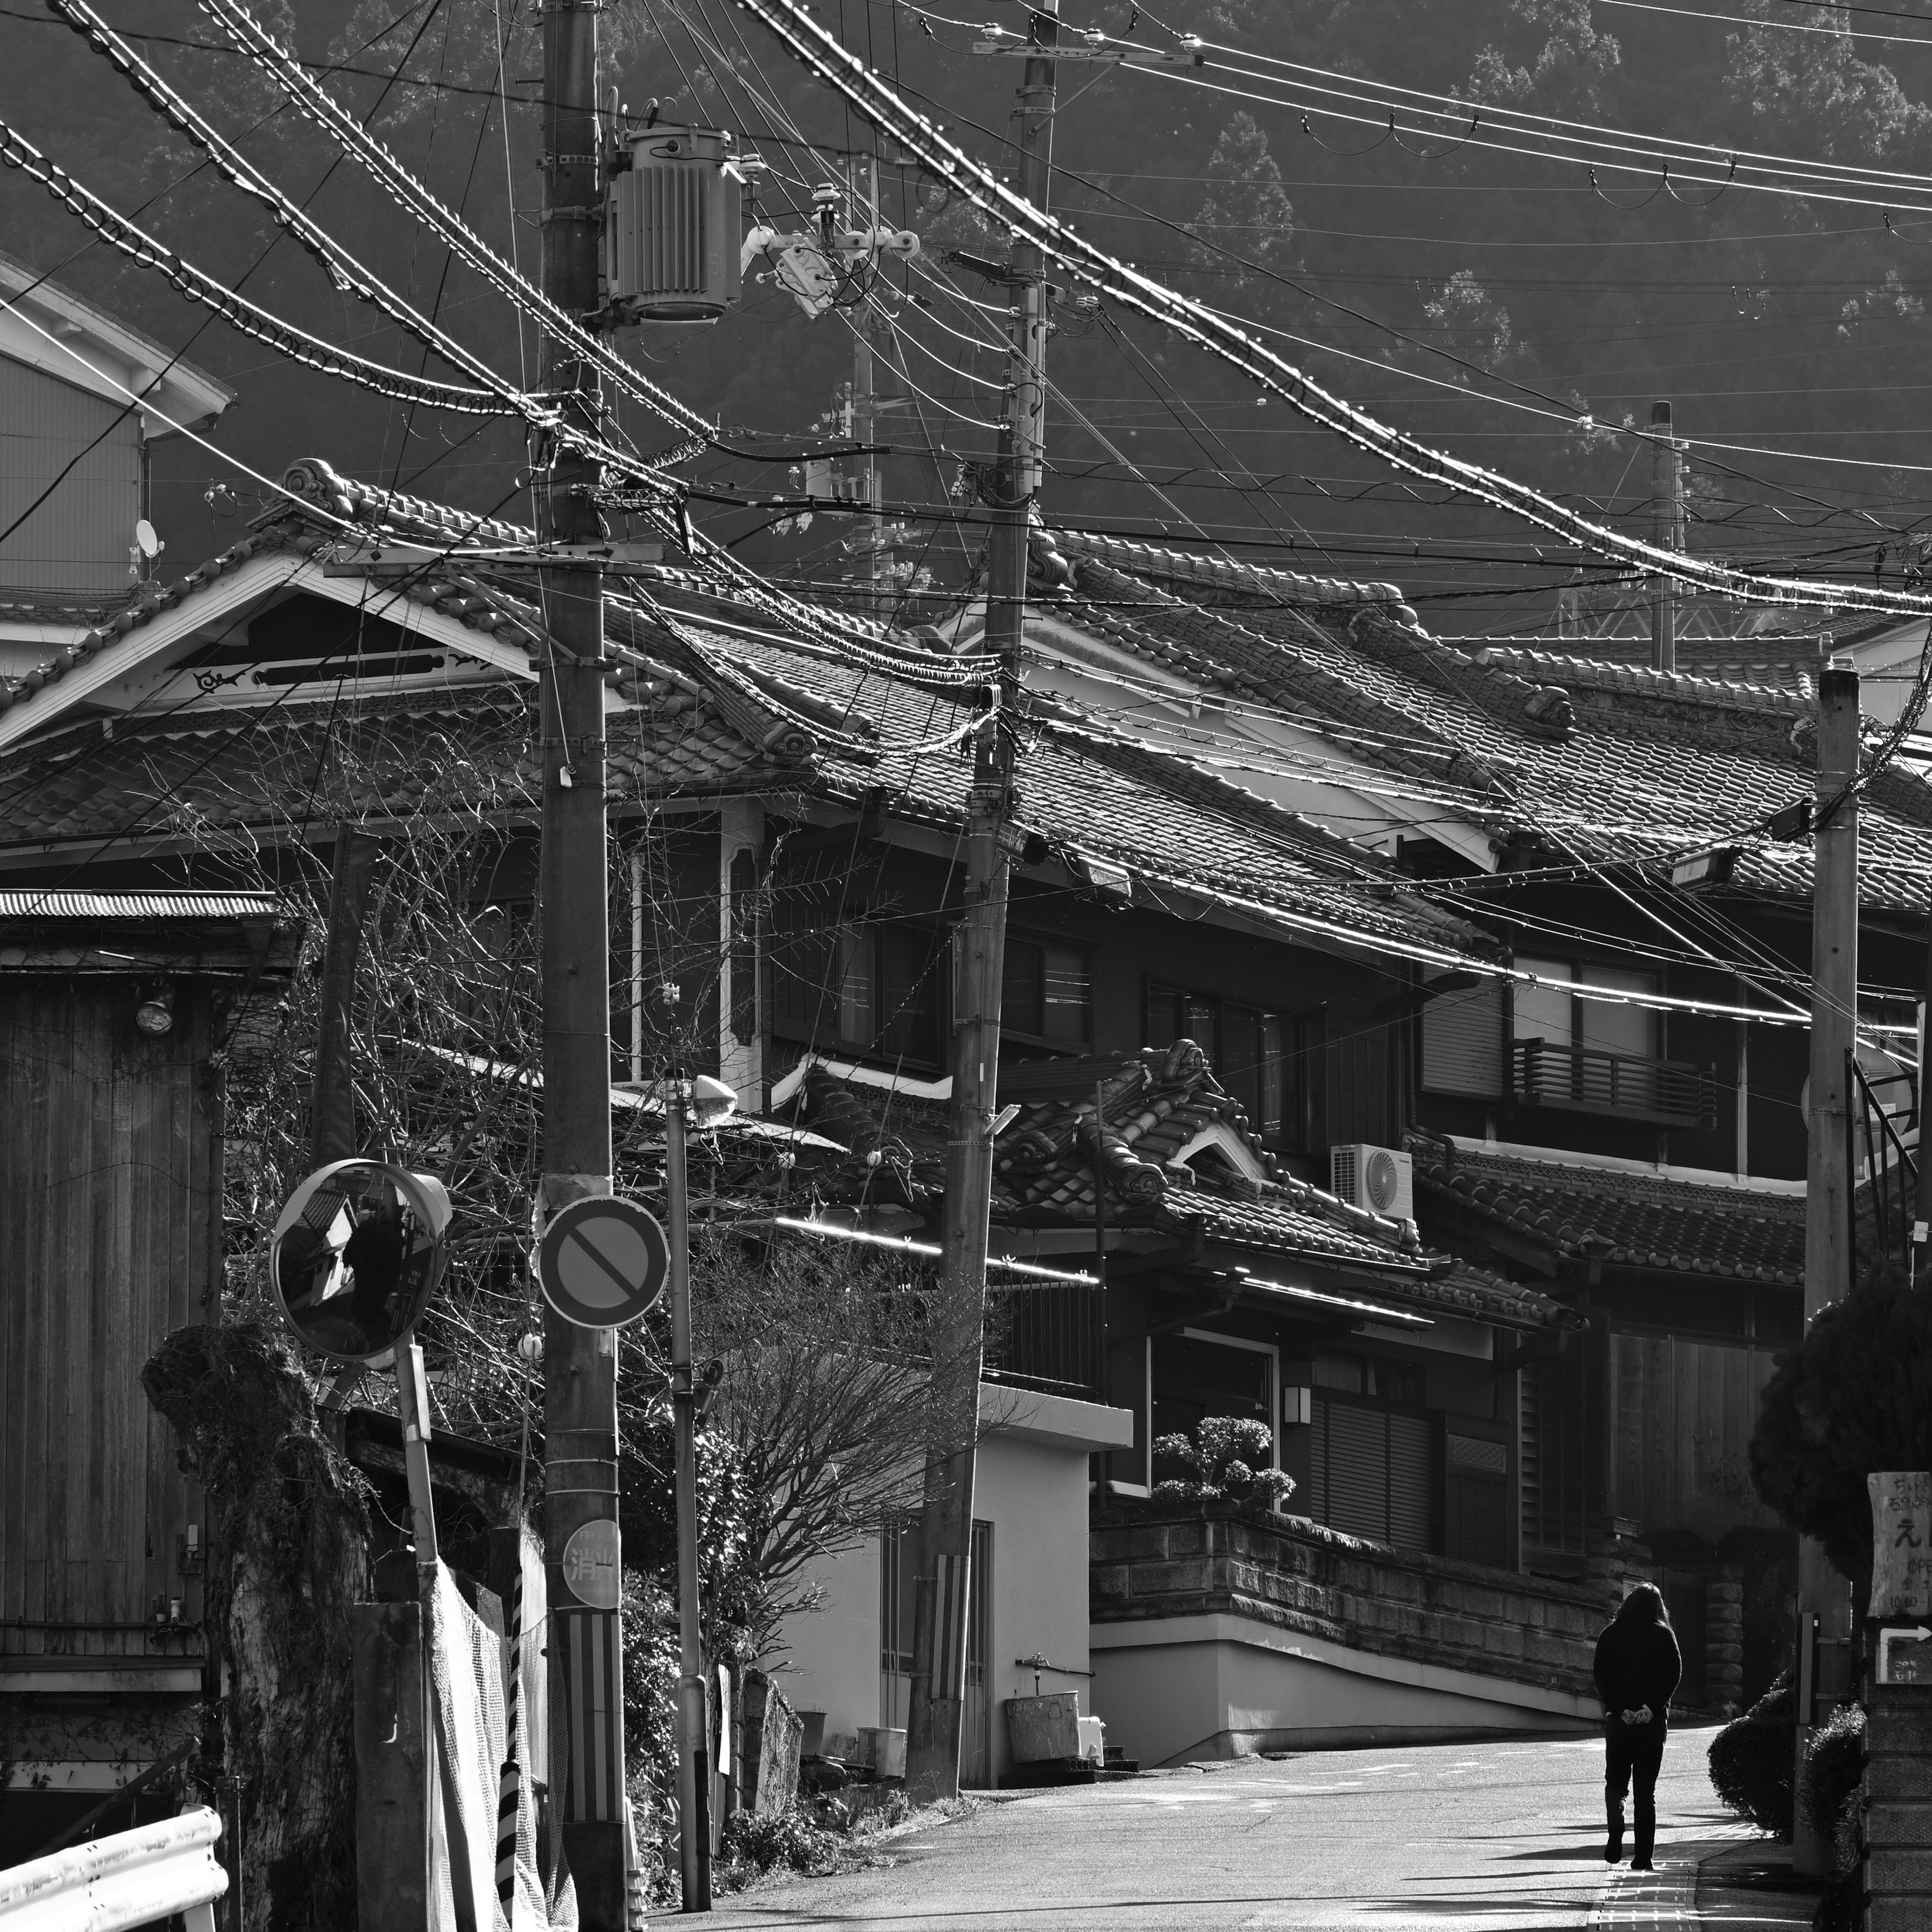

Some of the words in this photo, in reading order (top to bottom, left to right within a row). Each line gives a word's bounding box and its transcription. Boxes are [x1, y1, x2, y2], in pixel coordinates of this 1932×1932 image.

[580, 1531, 596, 1540] FIRE
[599, 1532, 613, 1542] HYD
[1894, 1518, 1932, 1548] え
